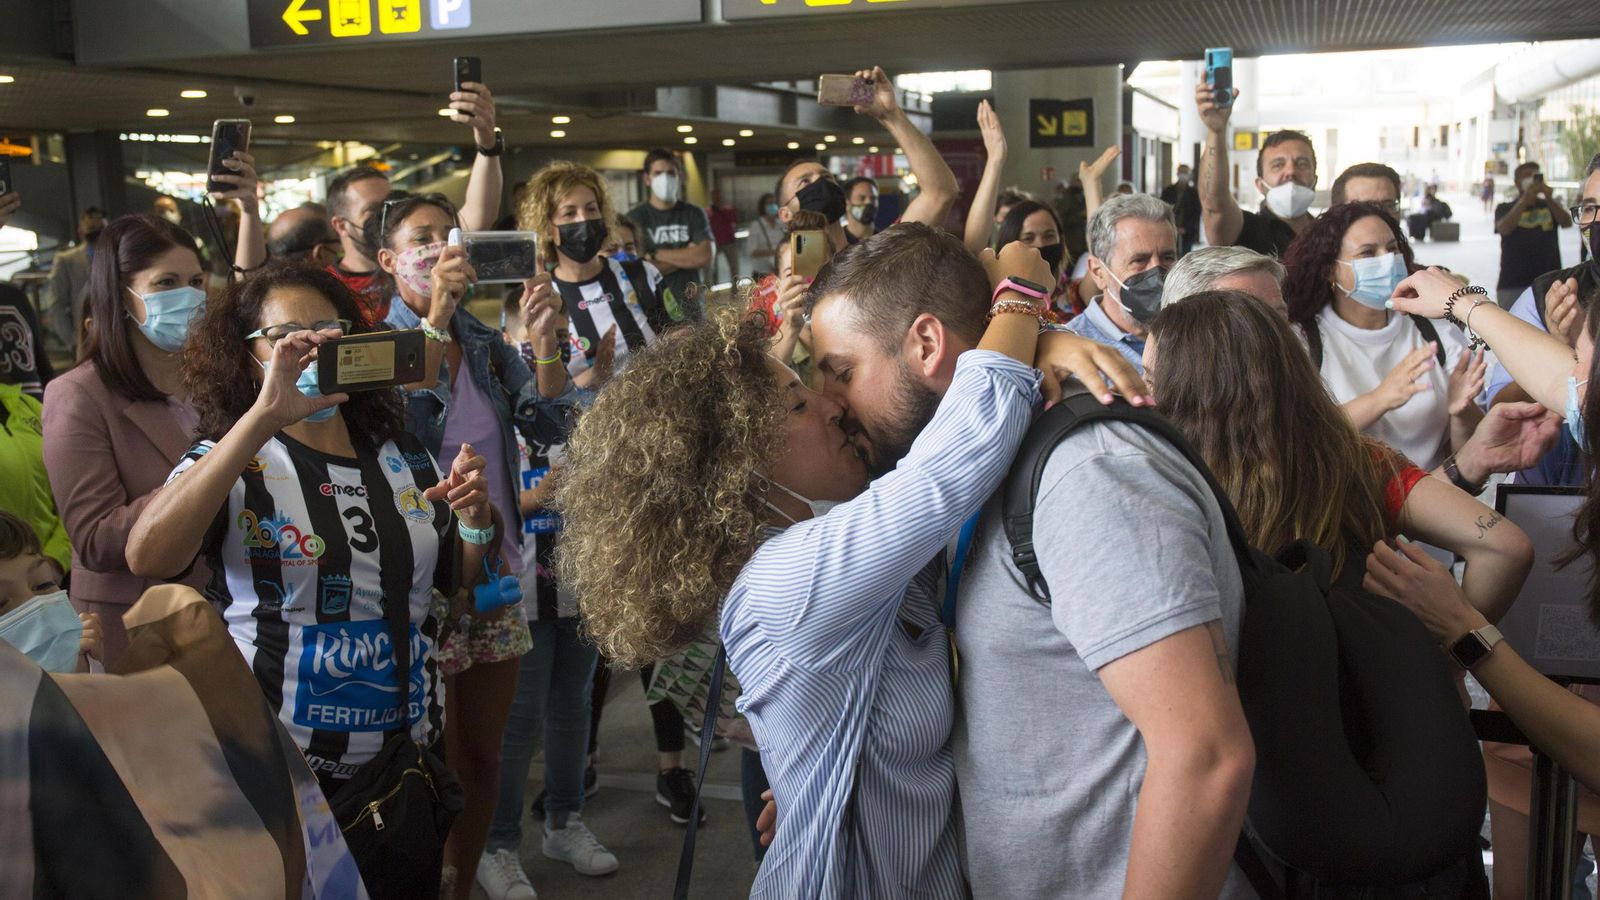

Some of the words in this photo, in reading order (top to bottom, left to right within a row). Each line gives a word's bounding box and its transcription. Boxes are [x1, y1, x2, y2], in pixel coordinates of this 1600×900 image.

[647, 224, 690, 244] VANS
[320, 482, 369, 499] emec
[237, 508, 326, 559] 2020
[342, 506, 380, 554] 3
